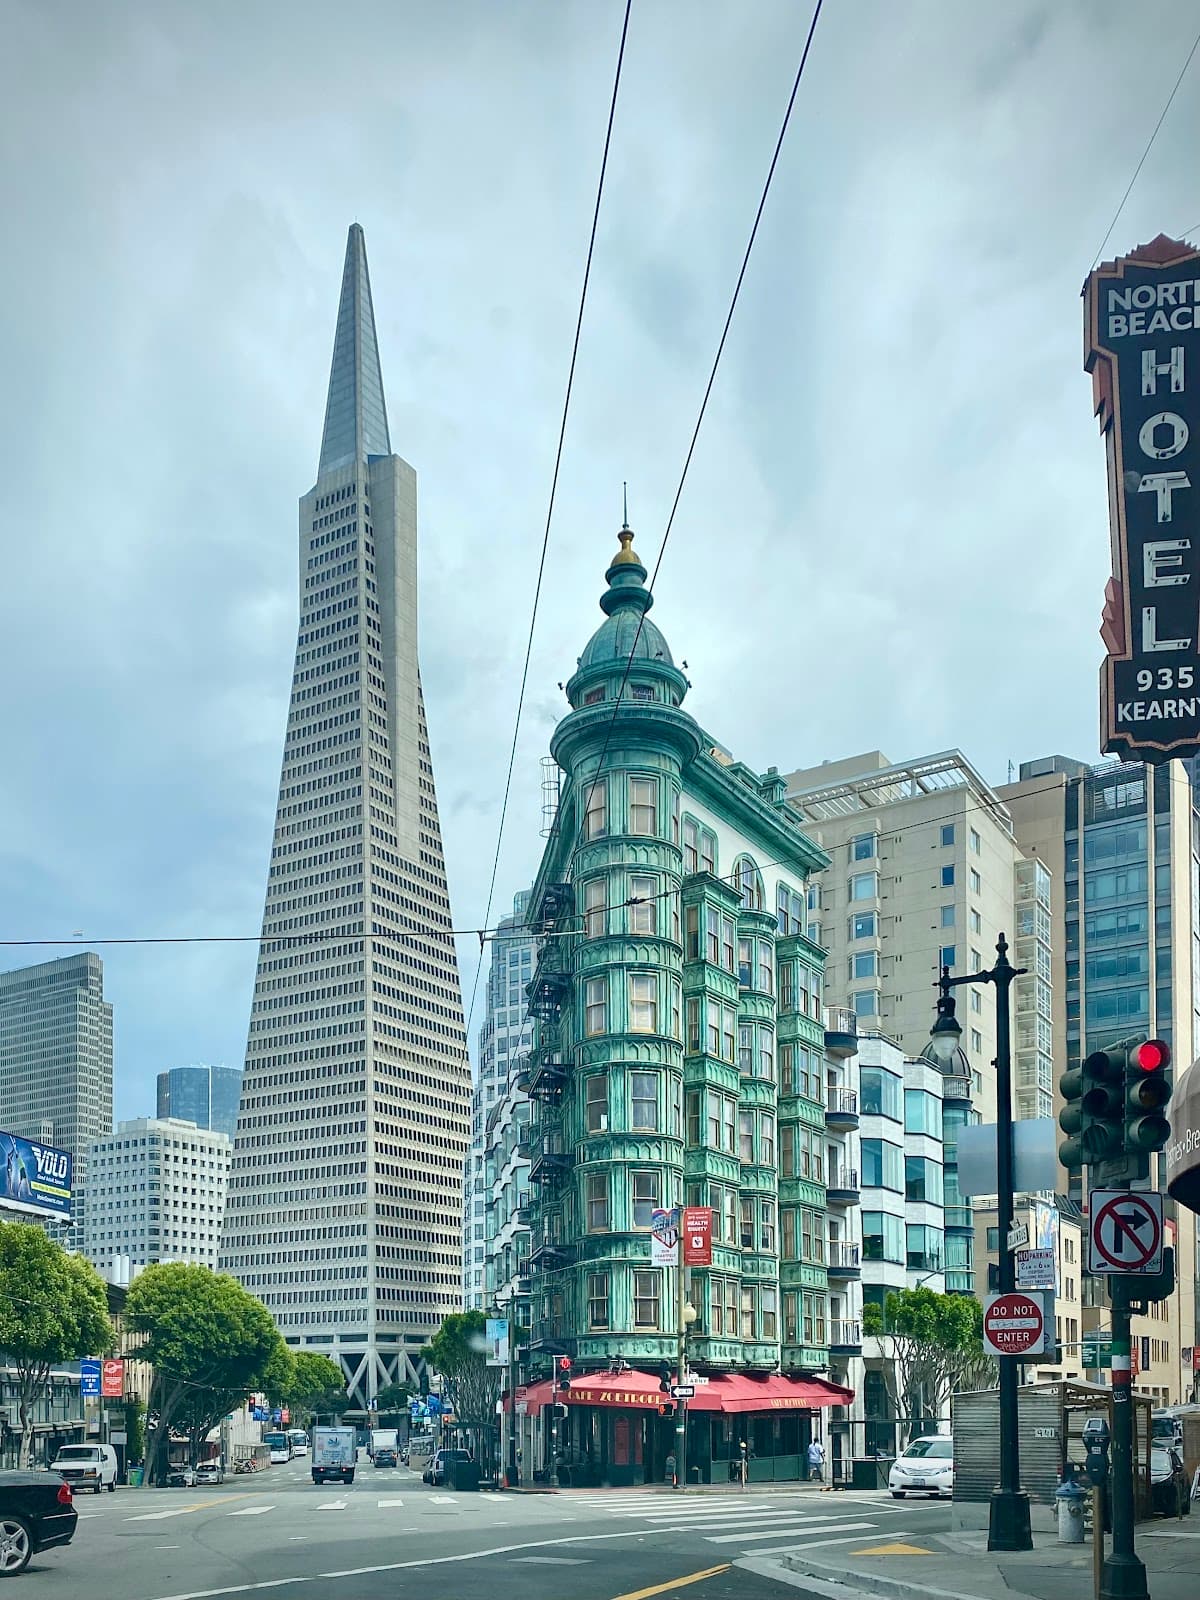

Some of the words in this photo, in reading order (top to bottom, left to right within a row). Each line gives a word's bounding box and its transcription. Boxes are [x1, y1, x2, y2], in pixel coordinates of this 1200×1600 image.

[1137, 345, 1193, 653] HOTEL
[1136, 666, 1194, 692] 935
[1117, 697, 1200, 722] KEARN
[31, 1146, 68, 1178] VOLO
[1018, 1251, 1028, 1261] NO
[1029, 1251, 1052, 1259] PARKING
[993, 1306, 1007, 1316] DO
[1013, 1305, 1035, 1316] NOT
[997, 1332, 1030, 1343] ENTER
[567, 1391, 594, 1401] CAFE
